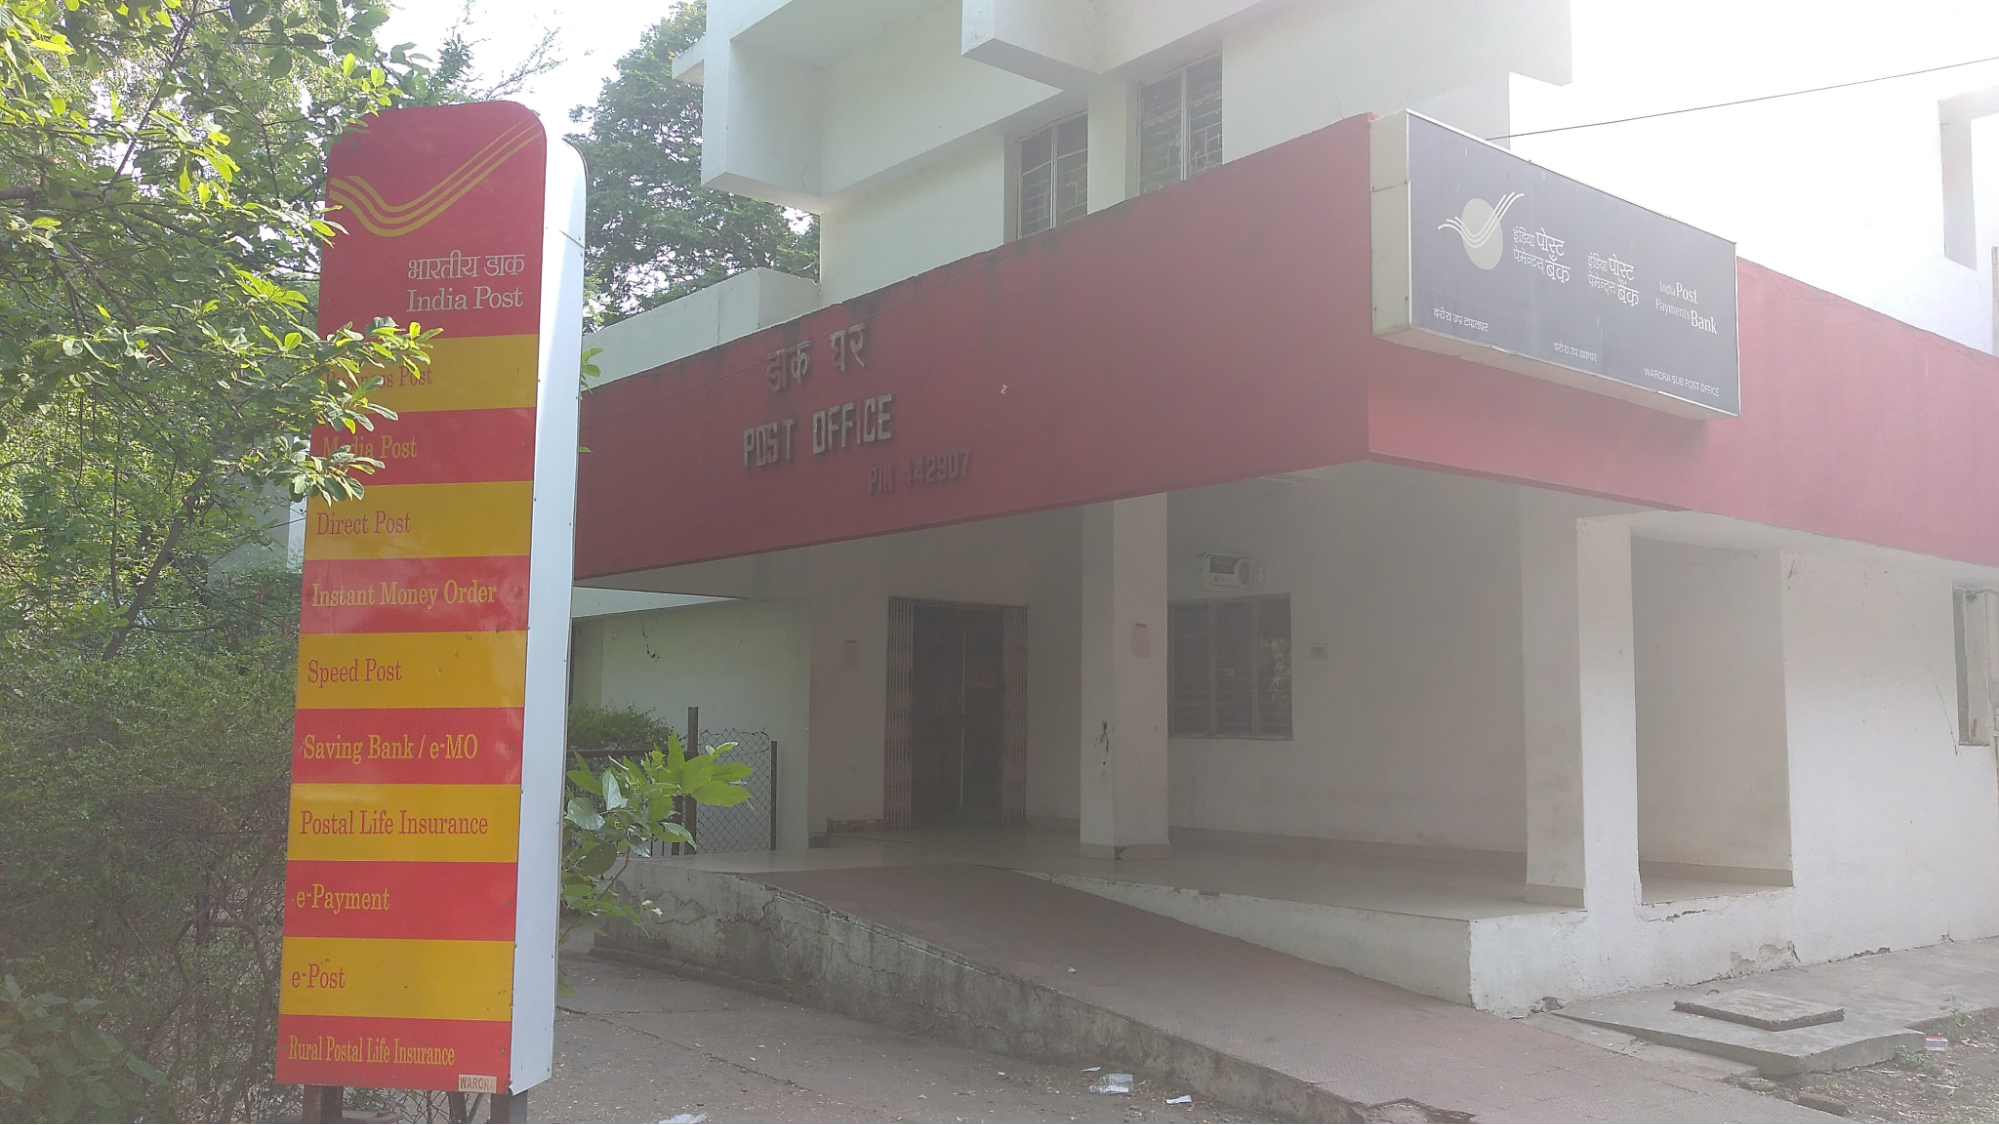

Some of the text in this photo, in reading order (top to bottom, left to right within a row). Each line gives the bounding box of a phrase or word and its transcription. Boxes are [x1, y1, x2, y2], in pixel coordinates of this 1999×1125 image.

[1535, 227, 1565, 256] पोस्ट
[408, 249, 525, 280] भारतीय डाक
[1608, 253, 1634, 280] पोस्ट
[406, 286, 523, 312] India Post
[398, 364, 433, 387] Post
[1643, 368, 1720, 397] WARORA SUB POST OFFICE
[743, 394, 893, 467] POST OFFICE
[323, 434, 418, 459] Mdia Post
[868, 448, 970, 494] PIN 442907
[316, 510, 412, 536] Direct Post
[311, 579, 497, 610] Instant Money Order
[307, 658, 402, 688] Speed Post
[303, 733, 478, 765] Saving Bank / e-MO
[300, 809, 488, 835] Postal Life Insurance
[296, 883, 390, 915] e-Payment
[291, 963, 345, 989] e-Post
[288, 1035, 455, 1066] Rural Postal Life Insurance
